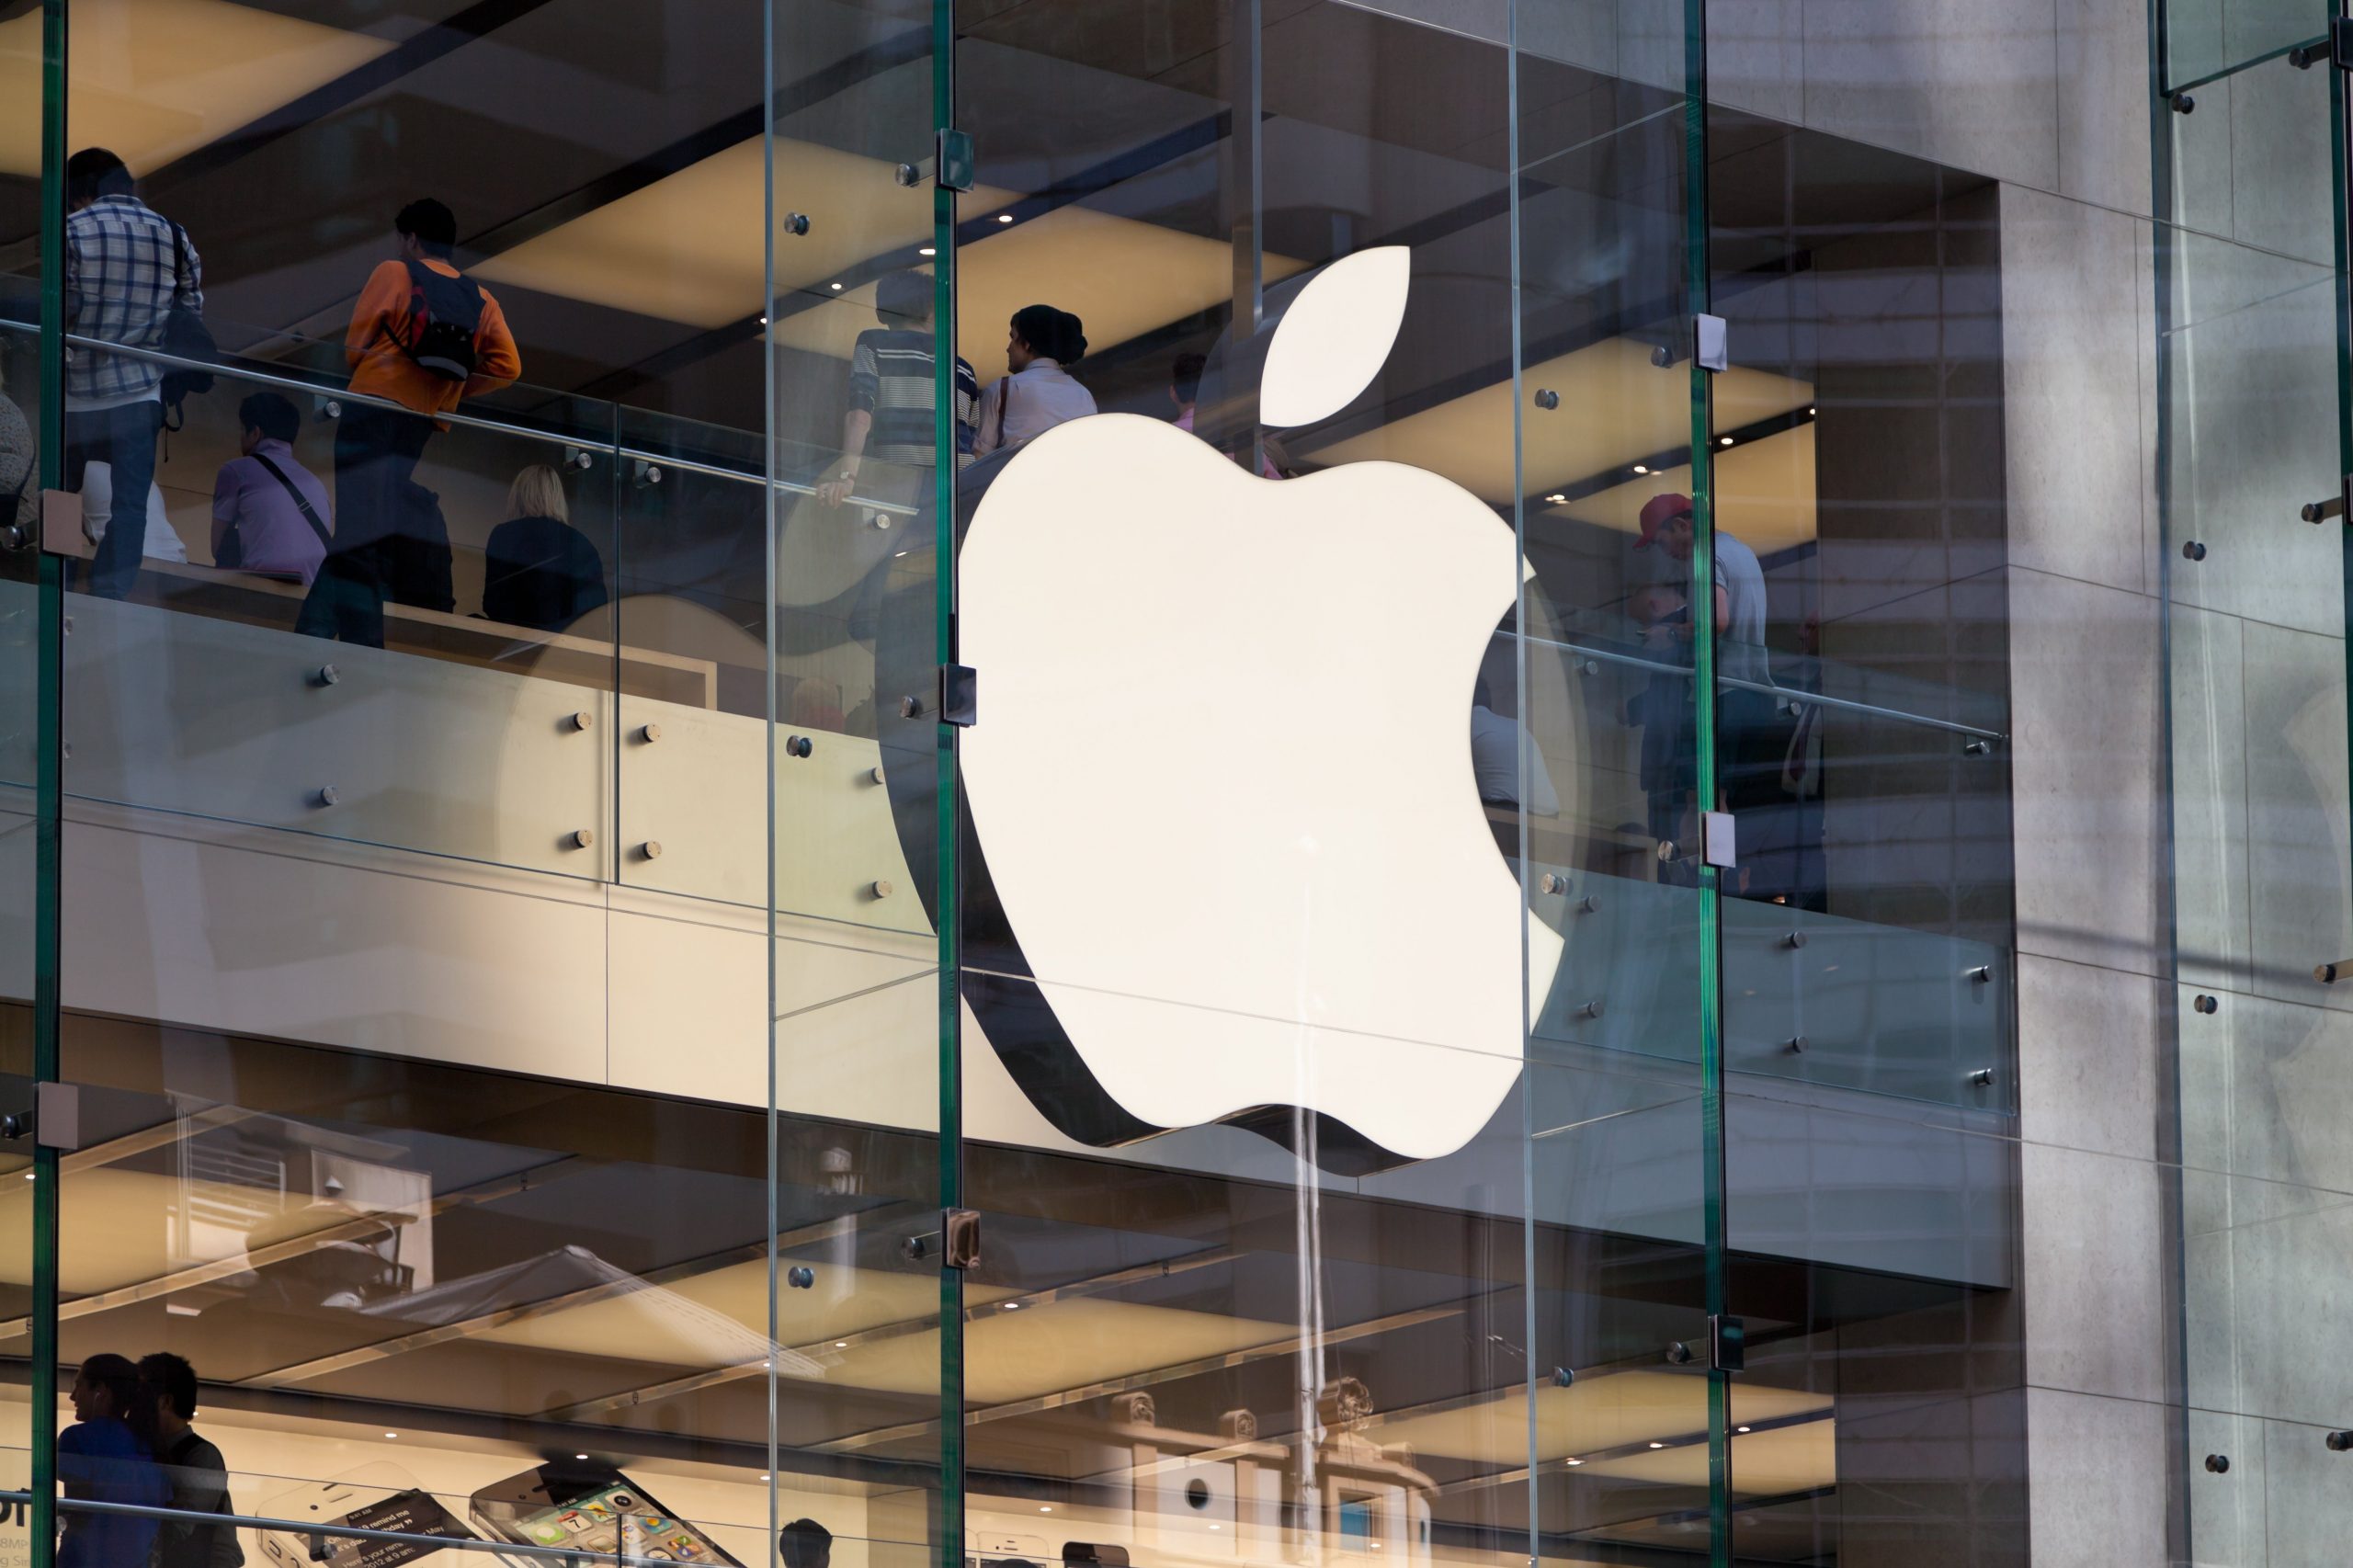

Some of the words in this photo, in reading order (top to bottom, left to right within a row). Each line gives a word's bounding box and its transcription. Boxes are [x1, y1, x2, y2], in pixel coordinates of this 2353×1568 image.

[370, 1515, 396, 1528] remind
[396, 1509, 410, 1519] me
[568, 1519, 580, 1528] 7
